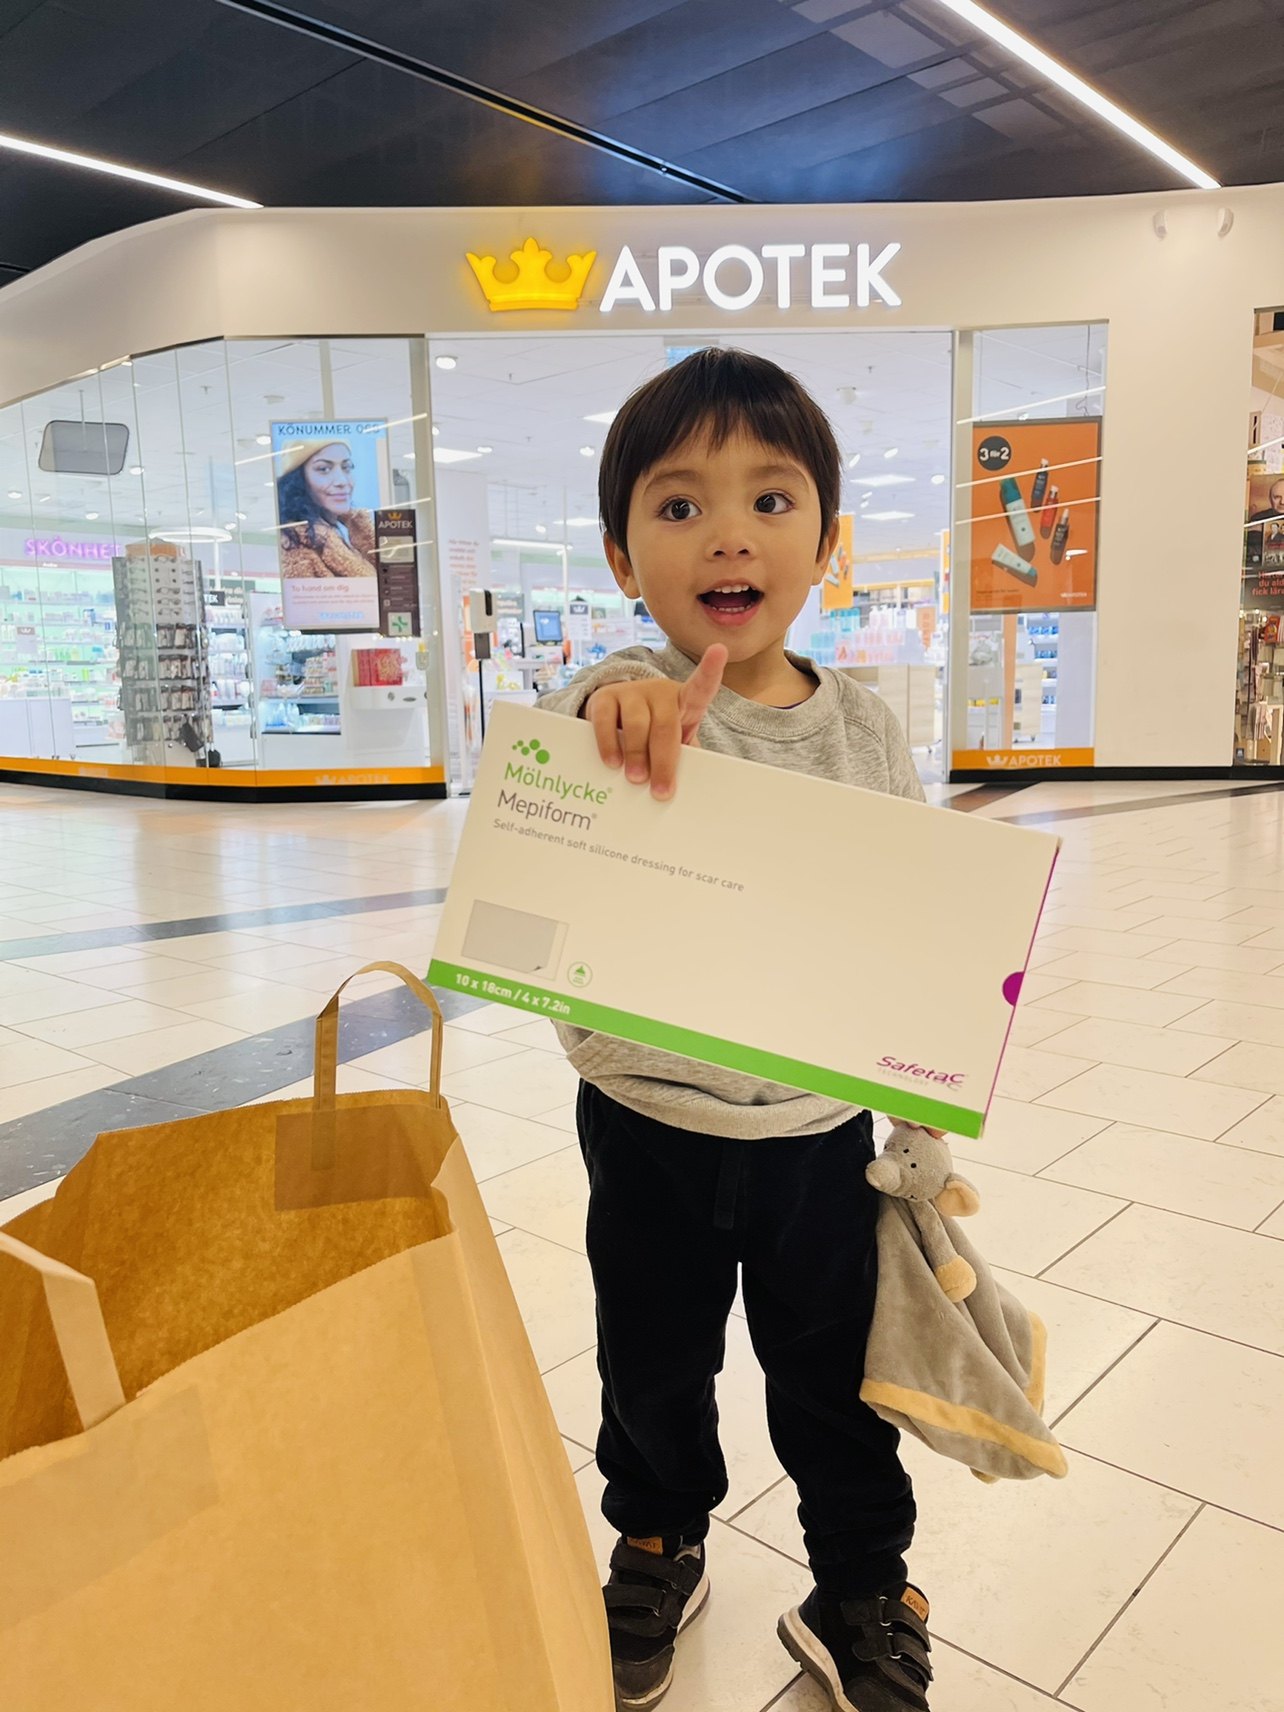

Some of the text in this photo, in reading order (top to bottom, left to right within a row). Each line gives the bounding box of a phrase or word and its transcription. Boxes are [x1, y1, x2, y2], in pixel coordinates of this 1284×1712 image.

[600, 243, 901, 312] APOTEK
[979, 448, 989, 461] 3
[1000, 447, 1010, 460] 2
[378, 520, 413, 529] APOTEK
[1008, 754, 1062, 767] APOTEK
[504, 762, 607, 804] Mölnlycke
[497, 789, 591, 830] Mepiform
[493, 818, 745, 892] Self-adherent soft silicone dressing for scar care
[456, 973, 571, 1015] 10 x 18cm / 4 x 7.2in
